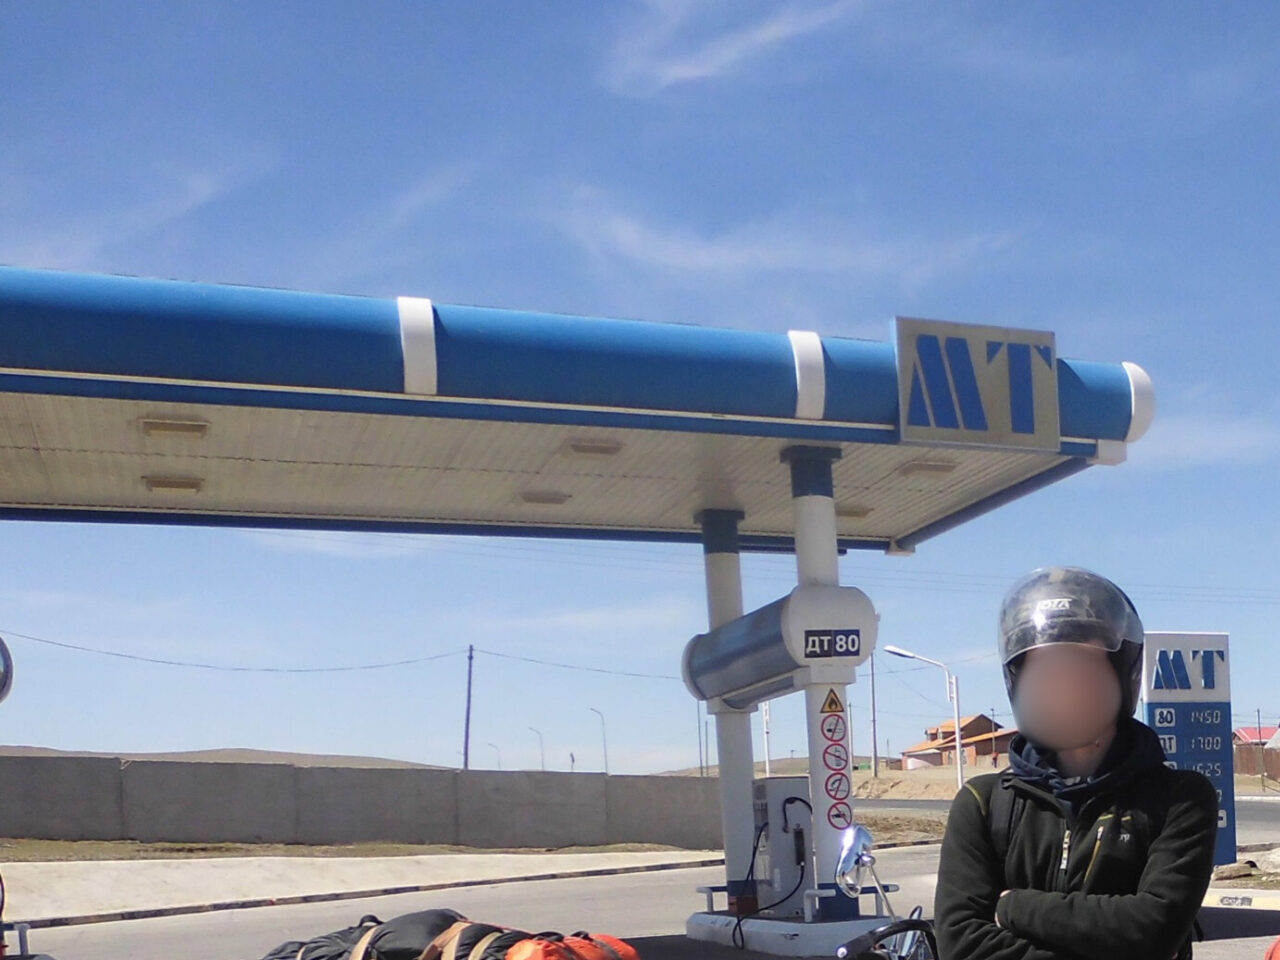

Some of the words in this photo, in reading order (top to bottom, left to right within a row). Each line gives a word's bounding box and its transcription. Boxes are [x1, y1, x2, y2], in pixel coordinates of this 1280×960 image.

[907, 334, 1052, 434] MT
[806, 636, 832, 654] ДТ
[835, 635, 859, 652] 80
[1152, 650, 1224, 690] MT
[1158, 710, 1174, 724] 80
[1191, 711, 1221, 724] 1450
[1192, 737, 1221, 750] 1700
